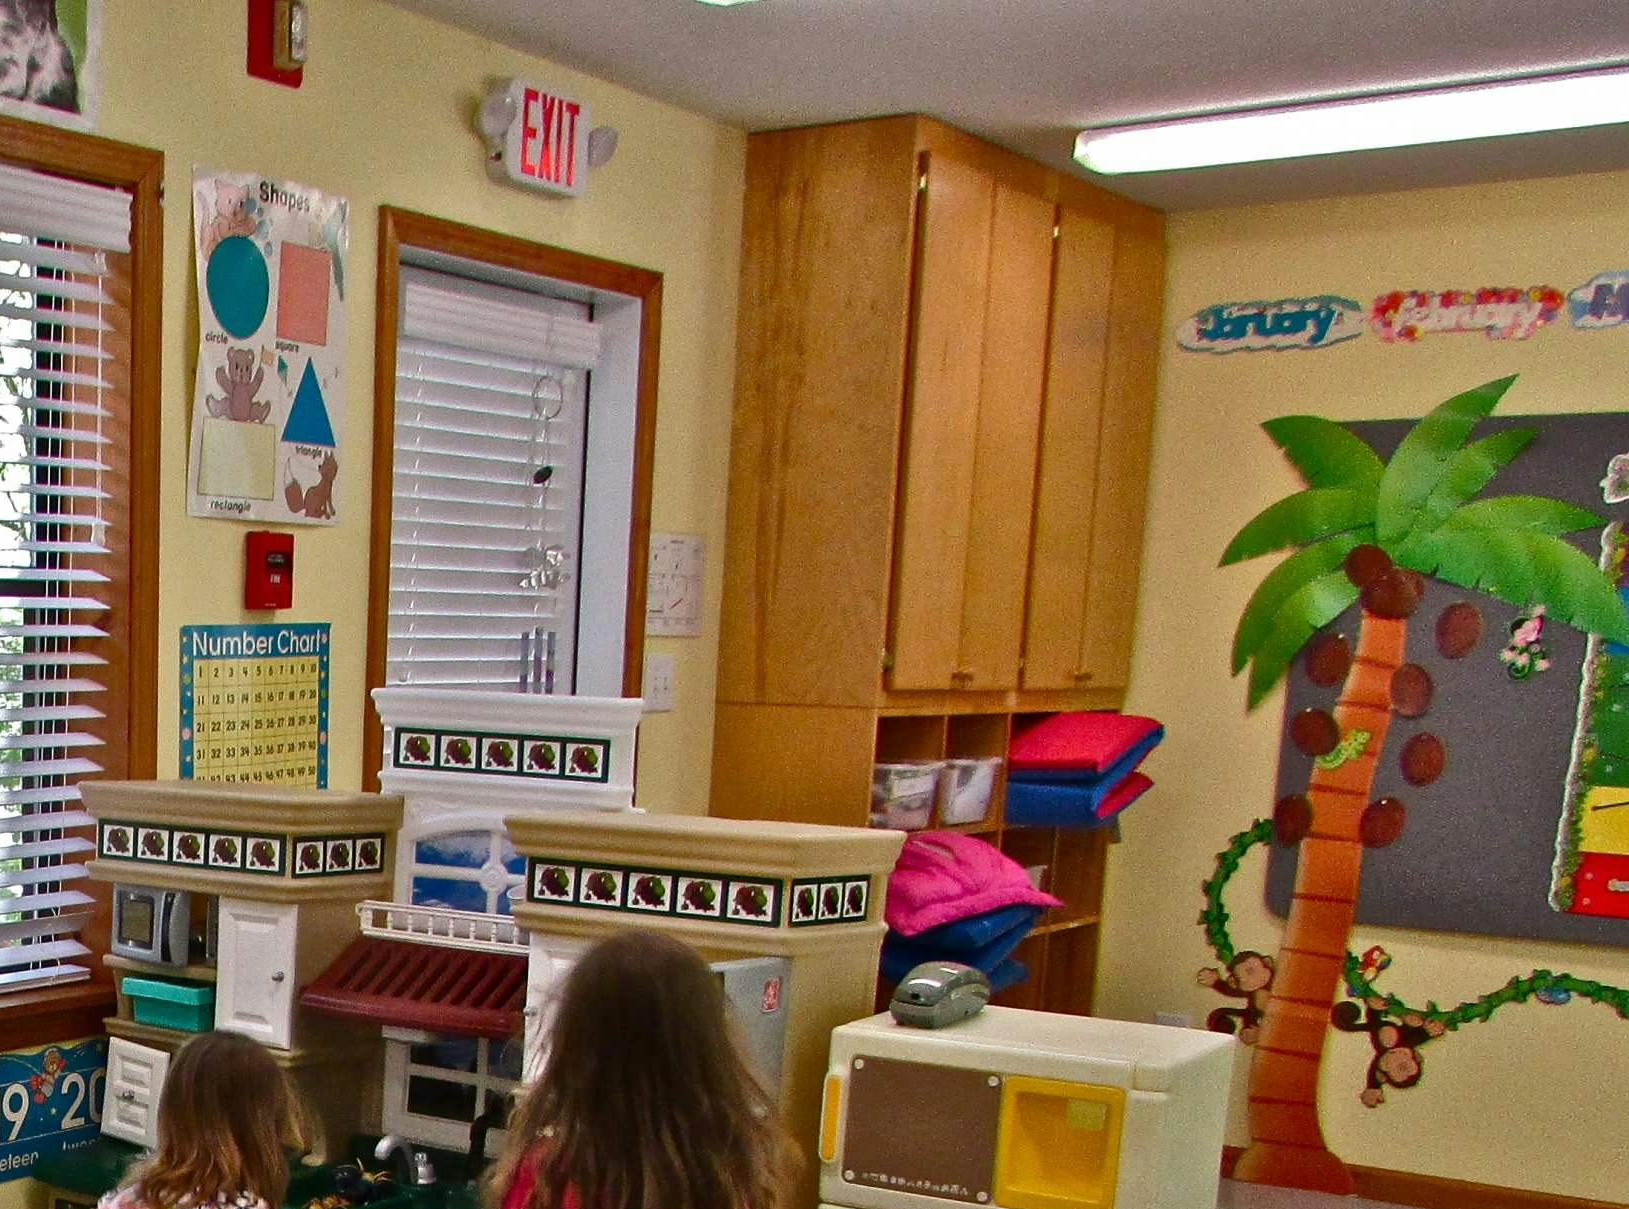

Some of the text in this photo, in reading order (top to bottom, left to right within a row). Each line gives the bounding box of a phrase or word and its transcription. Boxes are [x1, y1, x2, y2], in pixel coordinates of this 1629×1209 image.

[520, 87, 580, 187] EXIT
[259, 181, 310, 213] Shapes
[192, 629, 321, 656] Number Chart
[199, 666, 202, 678] 1
[214, 668, 219, 678] 2
[229, 667, 233, 677] 3
[243, 667, 248, 676] 4
[256, 666, 261, 676] 5
[268, 666, 273, 676] 6
[280, 665, 283, 674] 7
[290, 665, 294, 674] 8
[300, 664, 305, 673] 9
[197, 720, 249, 732] 21 22 23 24
